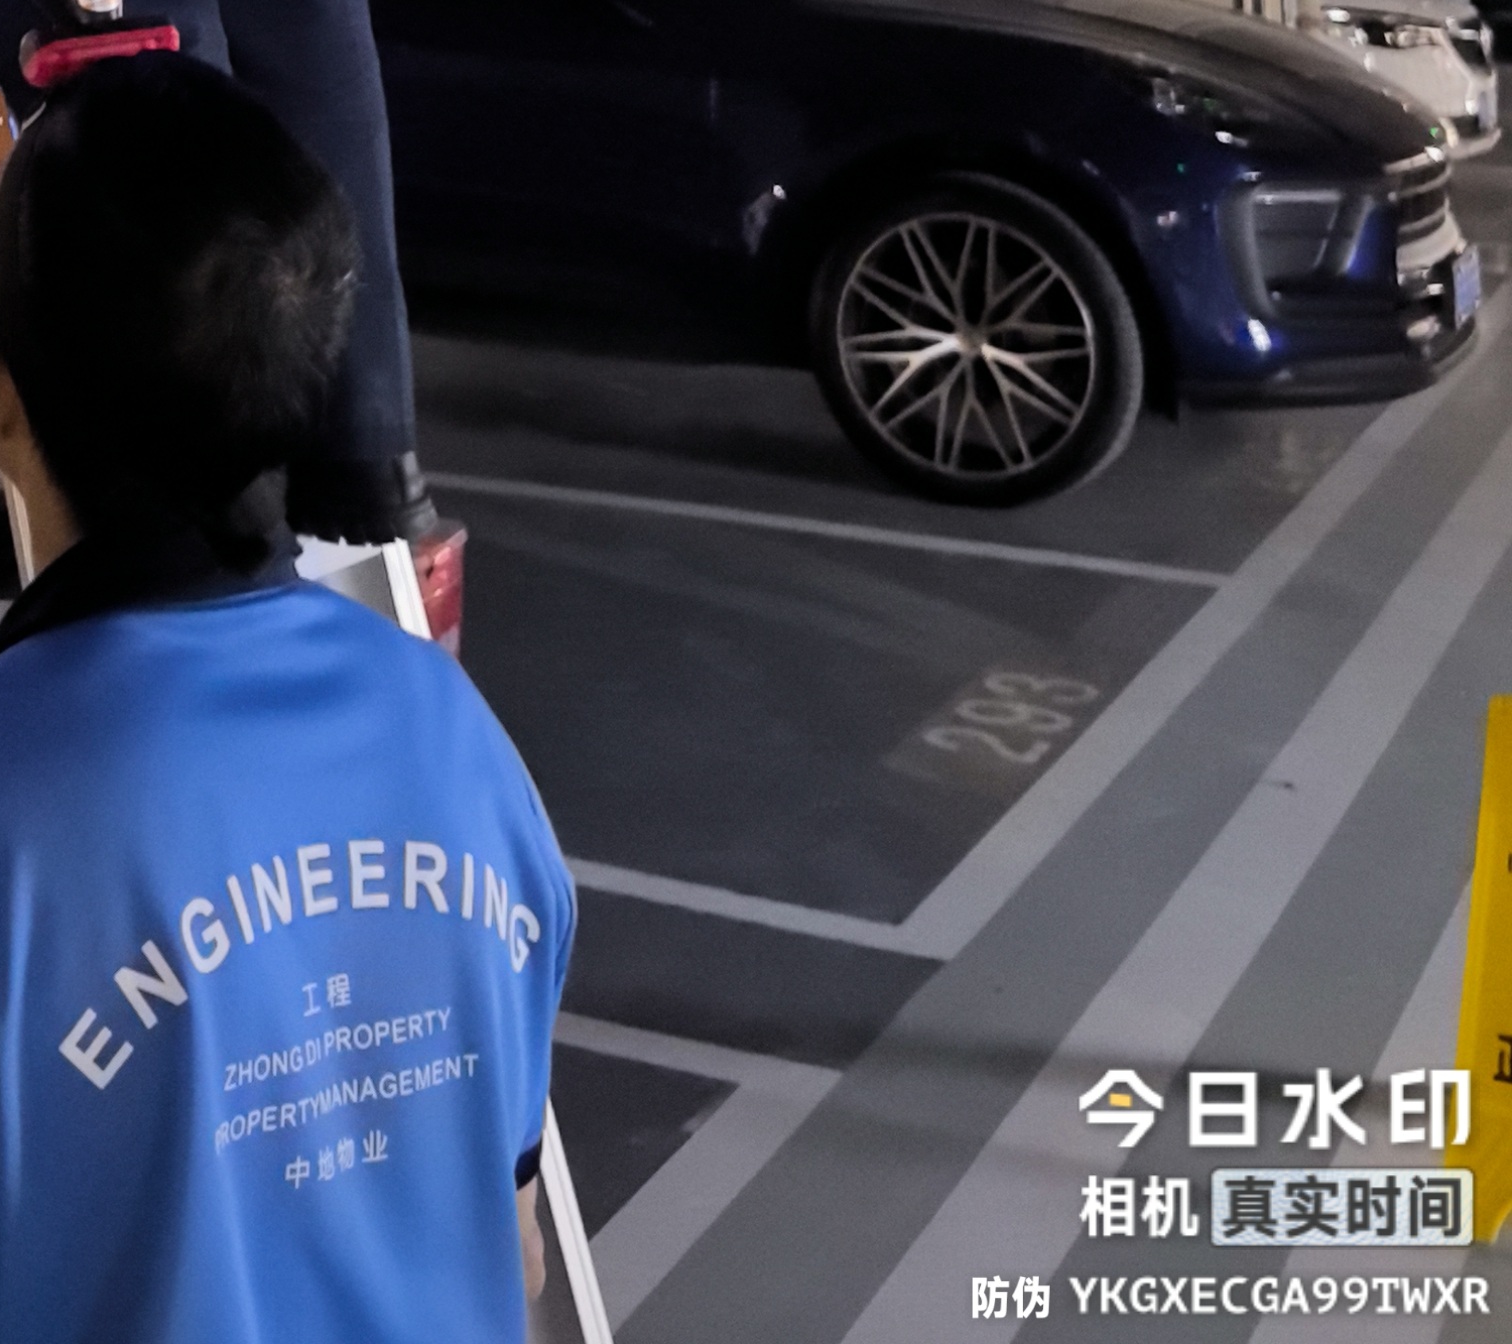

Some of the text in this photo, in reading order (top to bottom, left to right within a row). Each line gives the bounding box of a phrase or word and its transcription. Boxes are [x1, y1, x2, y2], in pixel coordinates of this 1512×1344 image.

[58, 838, 541, 1089] ENGINEERING
[301, 972, 352, 1017] 工程
[285, 1129, 388, 1189] 中地物业
